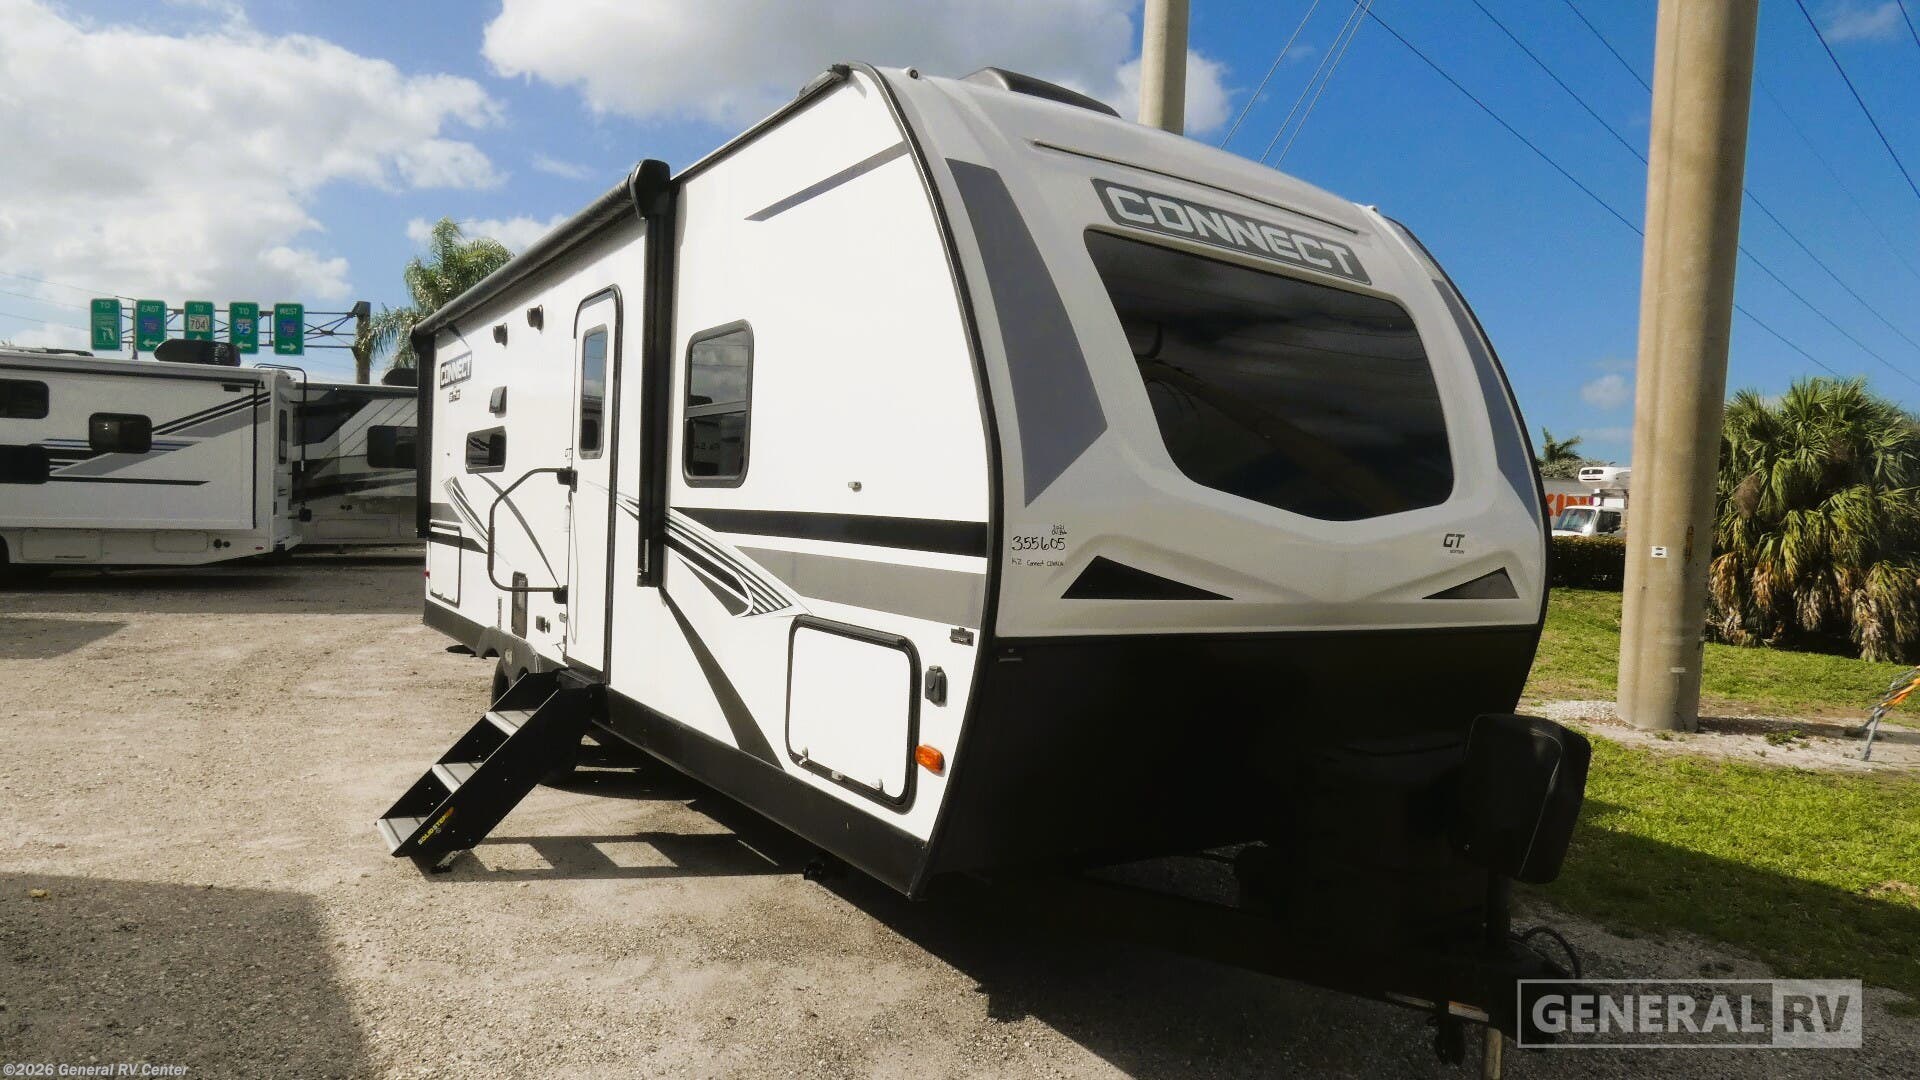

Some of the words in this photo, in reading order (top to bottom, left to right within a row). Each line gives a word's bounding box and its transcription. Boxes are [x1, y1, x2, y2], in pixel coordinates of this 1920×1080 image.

[1105, 185, 1353, 275] CONNECT
[141, 305, 160, 313] EAST
[194, 304, 204, 313] TO
[238, 307, 250, 316] TO
[280, 307, 297, 315] WEST
[190, 319, 206, 330] 704
[236, 323, 252, 334] 95
[440, 352, 472, 388] CONNECT
[1011, 535, 1066, 551] 355605
[1443, 533, 1466, 549] GT
